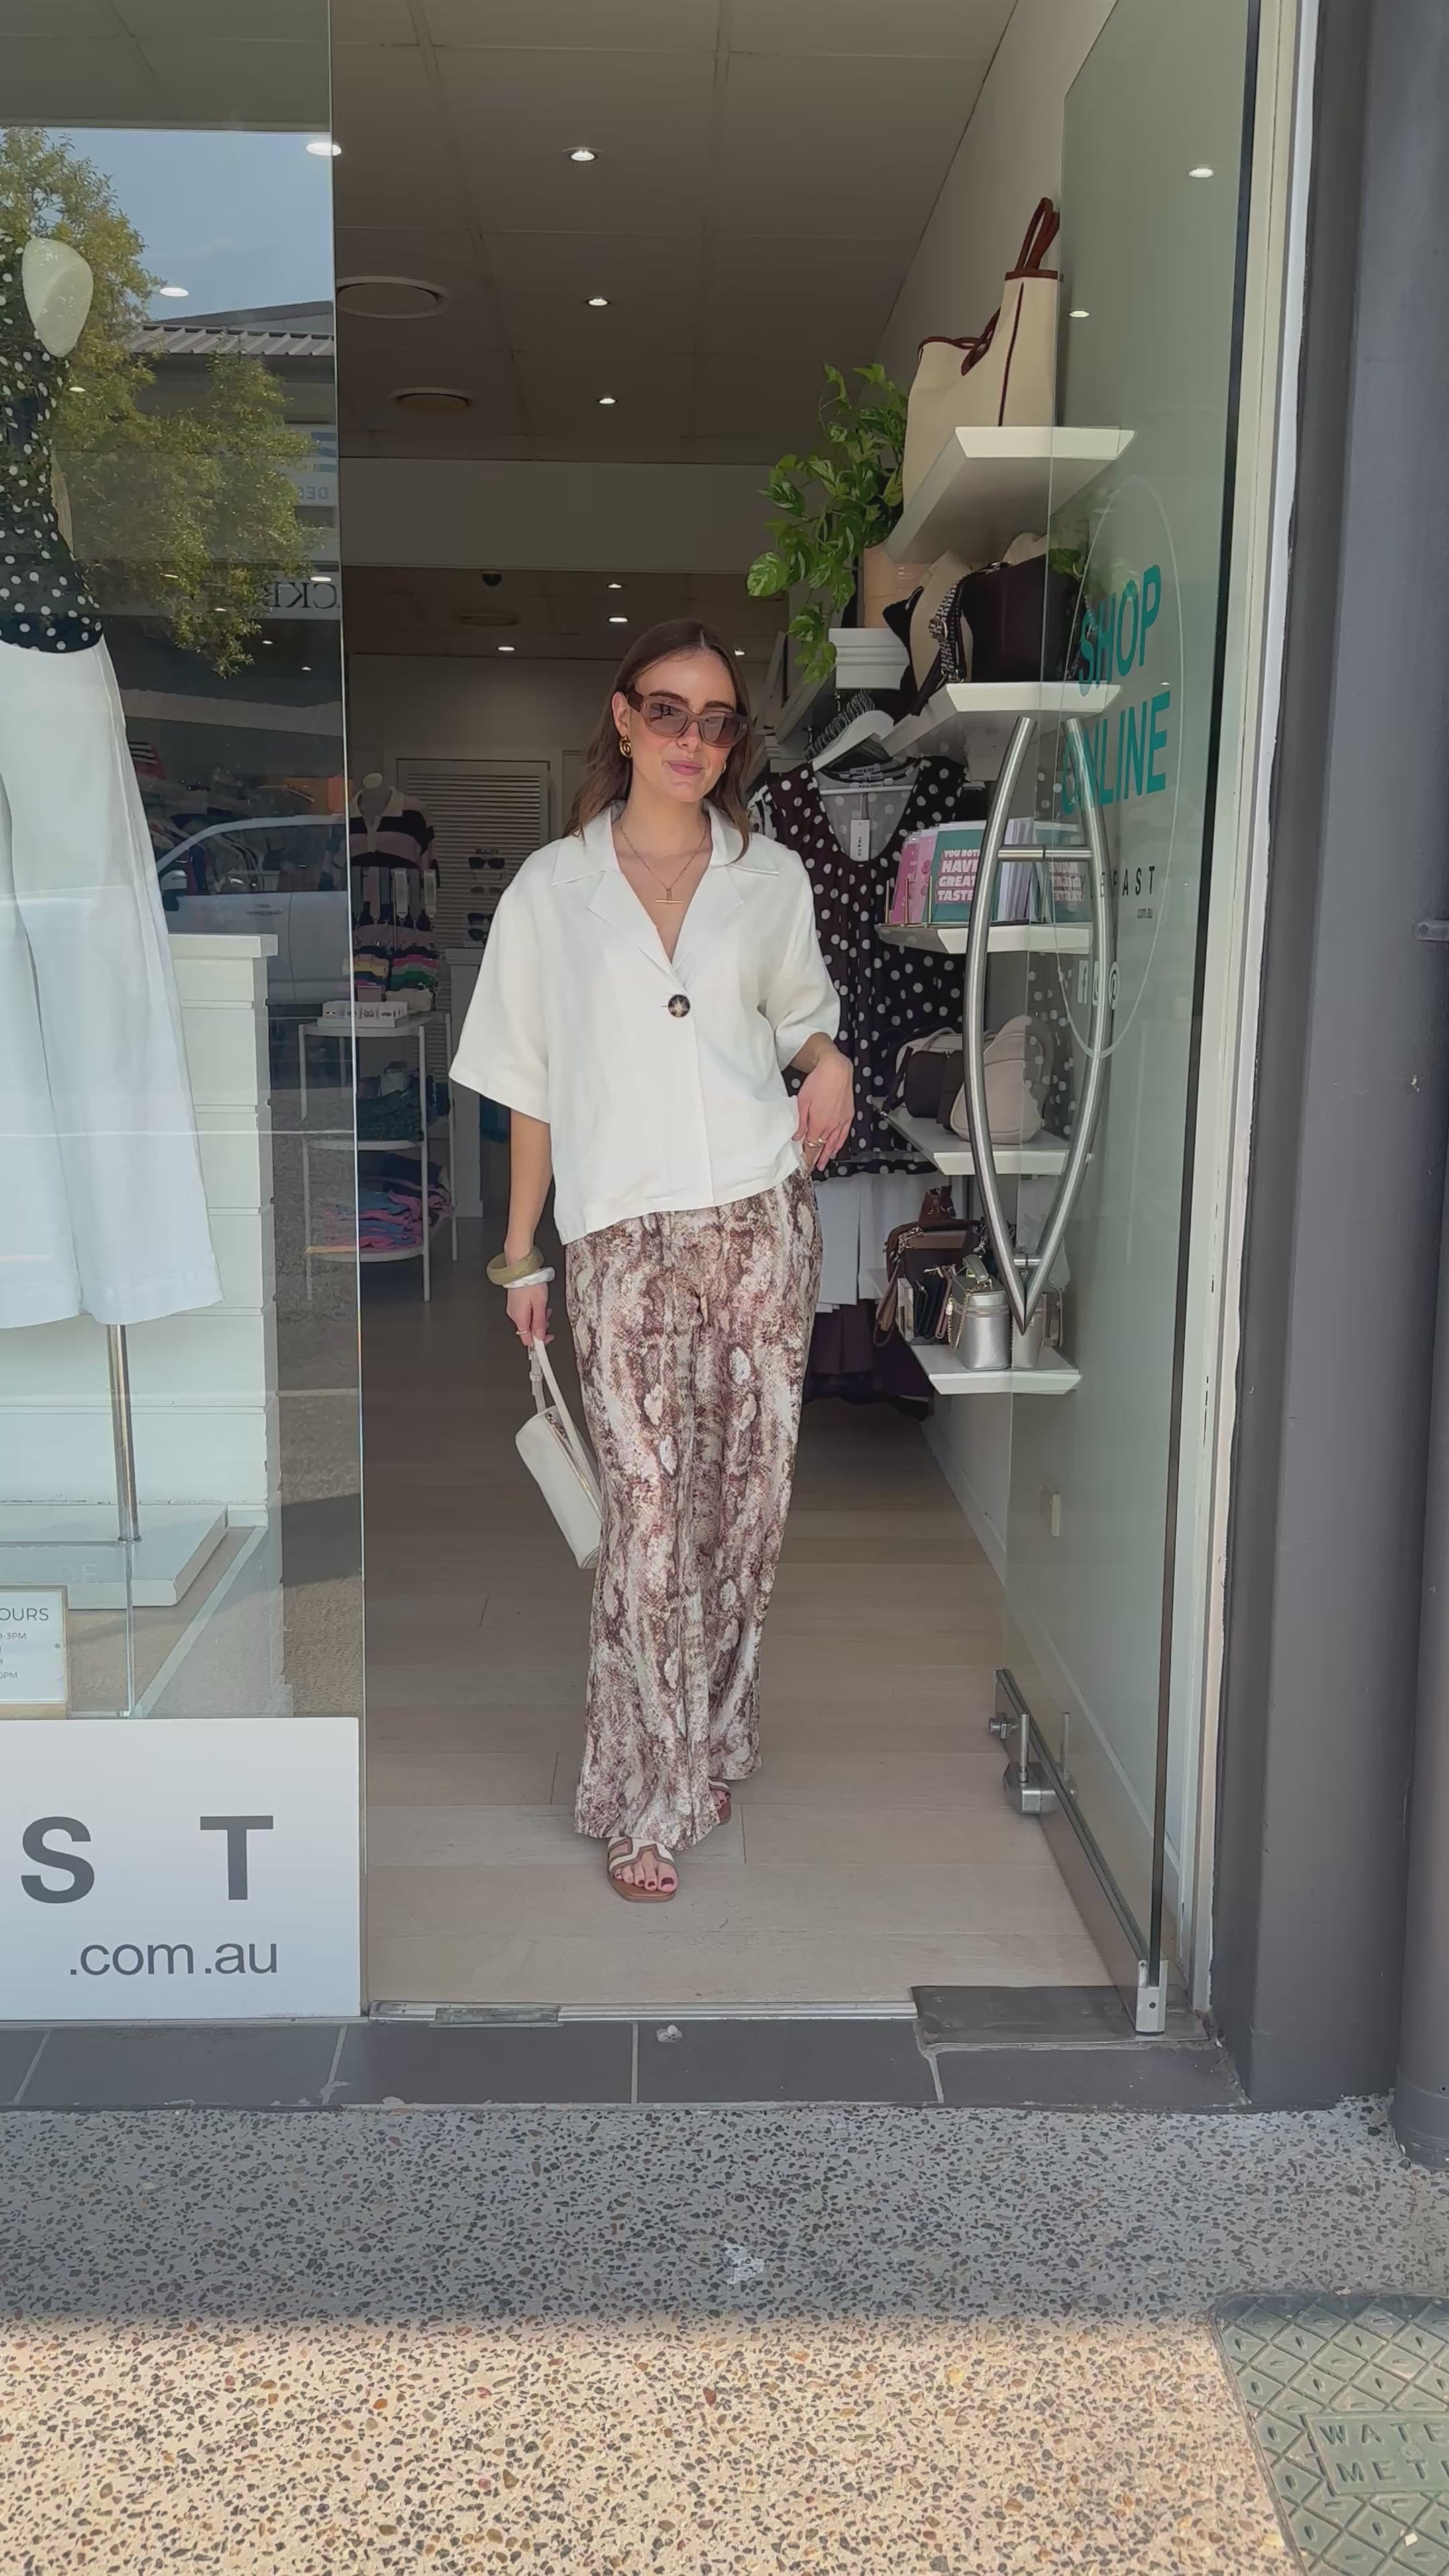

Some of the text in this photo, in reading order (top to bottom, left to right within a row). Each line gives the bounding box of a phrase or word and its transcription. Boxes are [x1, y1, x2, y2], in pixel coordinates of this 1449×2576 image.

[1079, 565, 1161, 697] SHOP
[961, 849, 979, 857] BOT
[70, 1943, 278, 1976] .com.au
